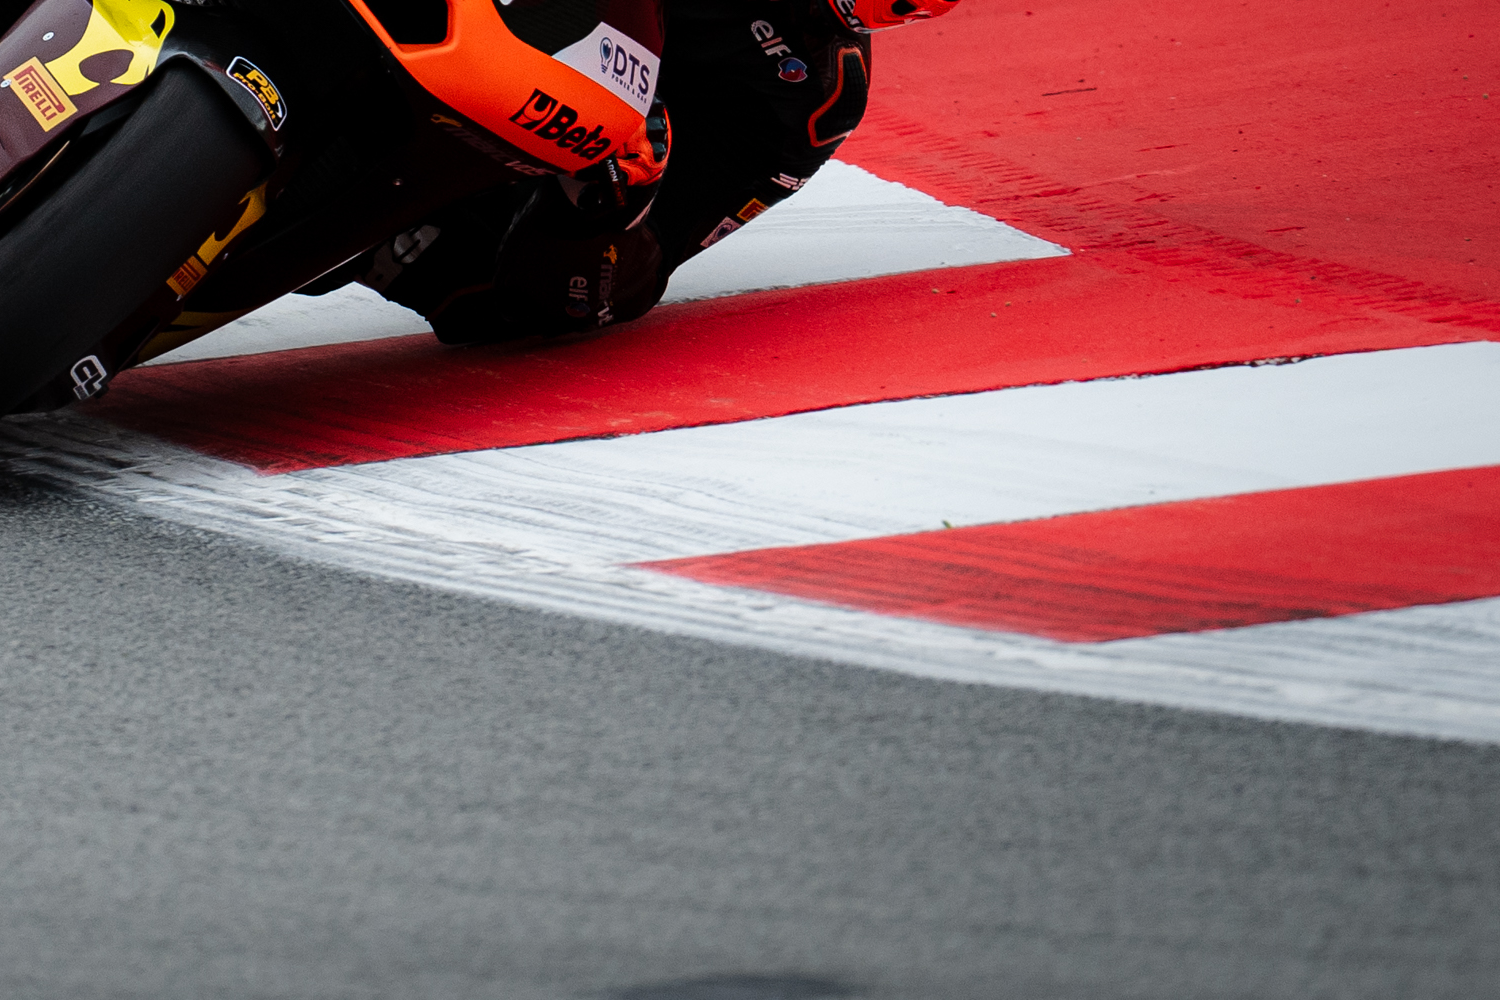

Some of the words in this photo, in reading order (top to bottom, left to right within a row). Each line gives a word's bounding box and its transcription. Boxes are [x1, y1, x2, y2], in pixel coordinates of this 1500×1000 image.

[751, 20, 790, 58] elf
[14, 65, 65, 121] PIRELLI
[246, 69, 279, 103] PB
[612, 45, 651, 96] DTS
[544, 107, 610, 162] Beta
